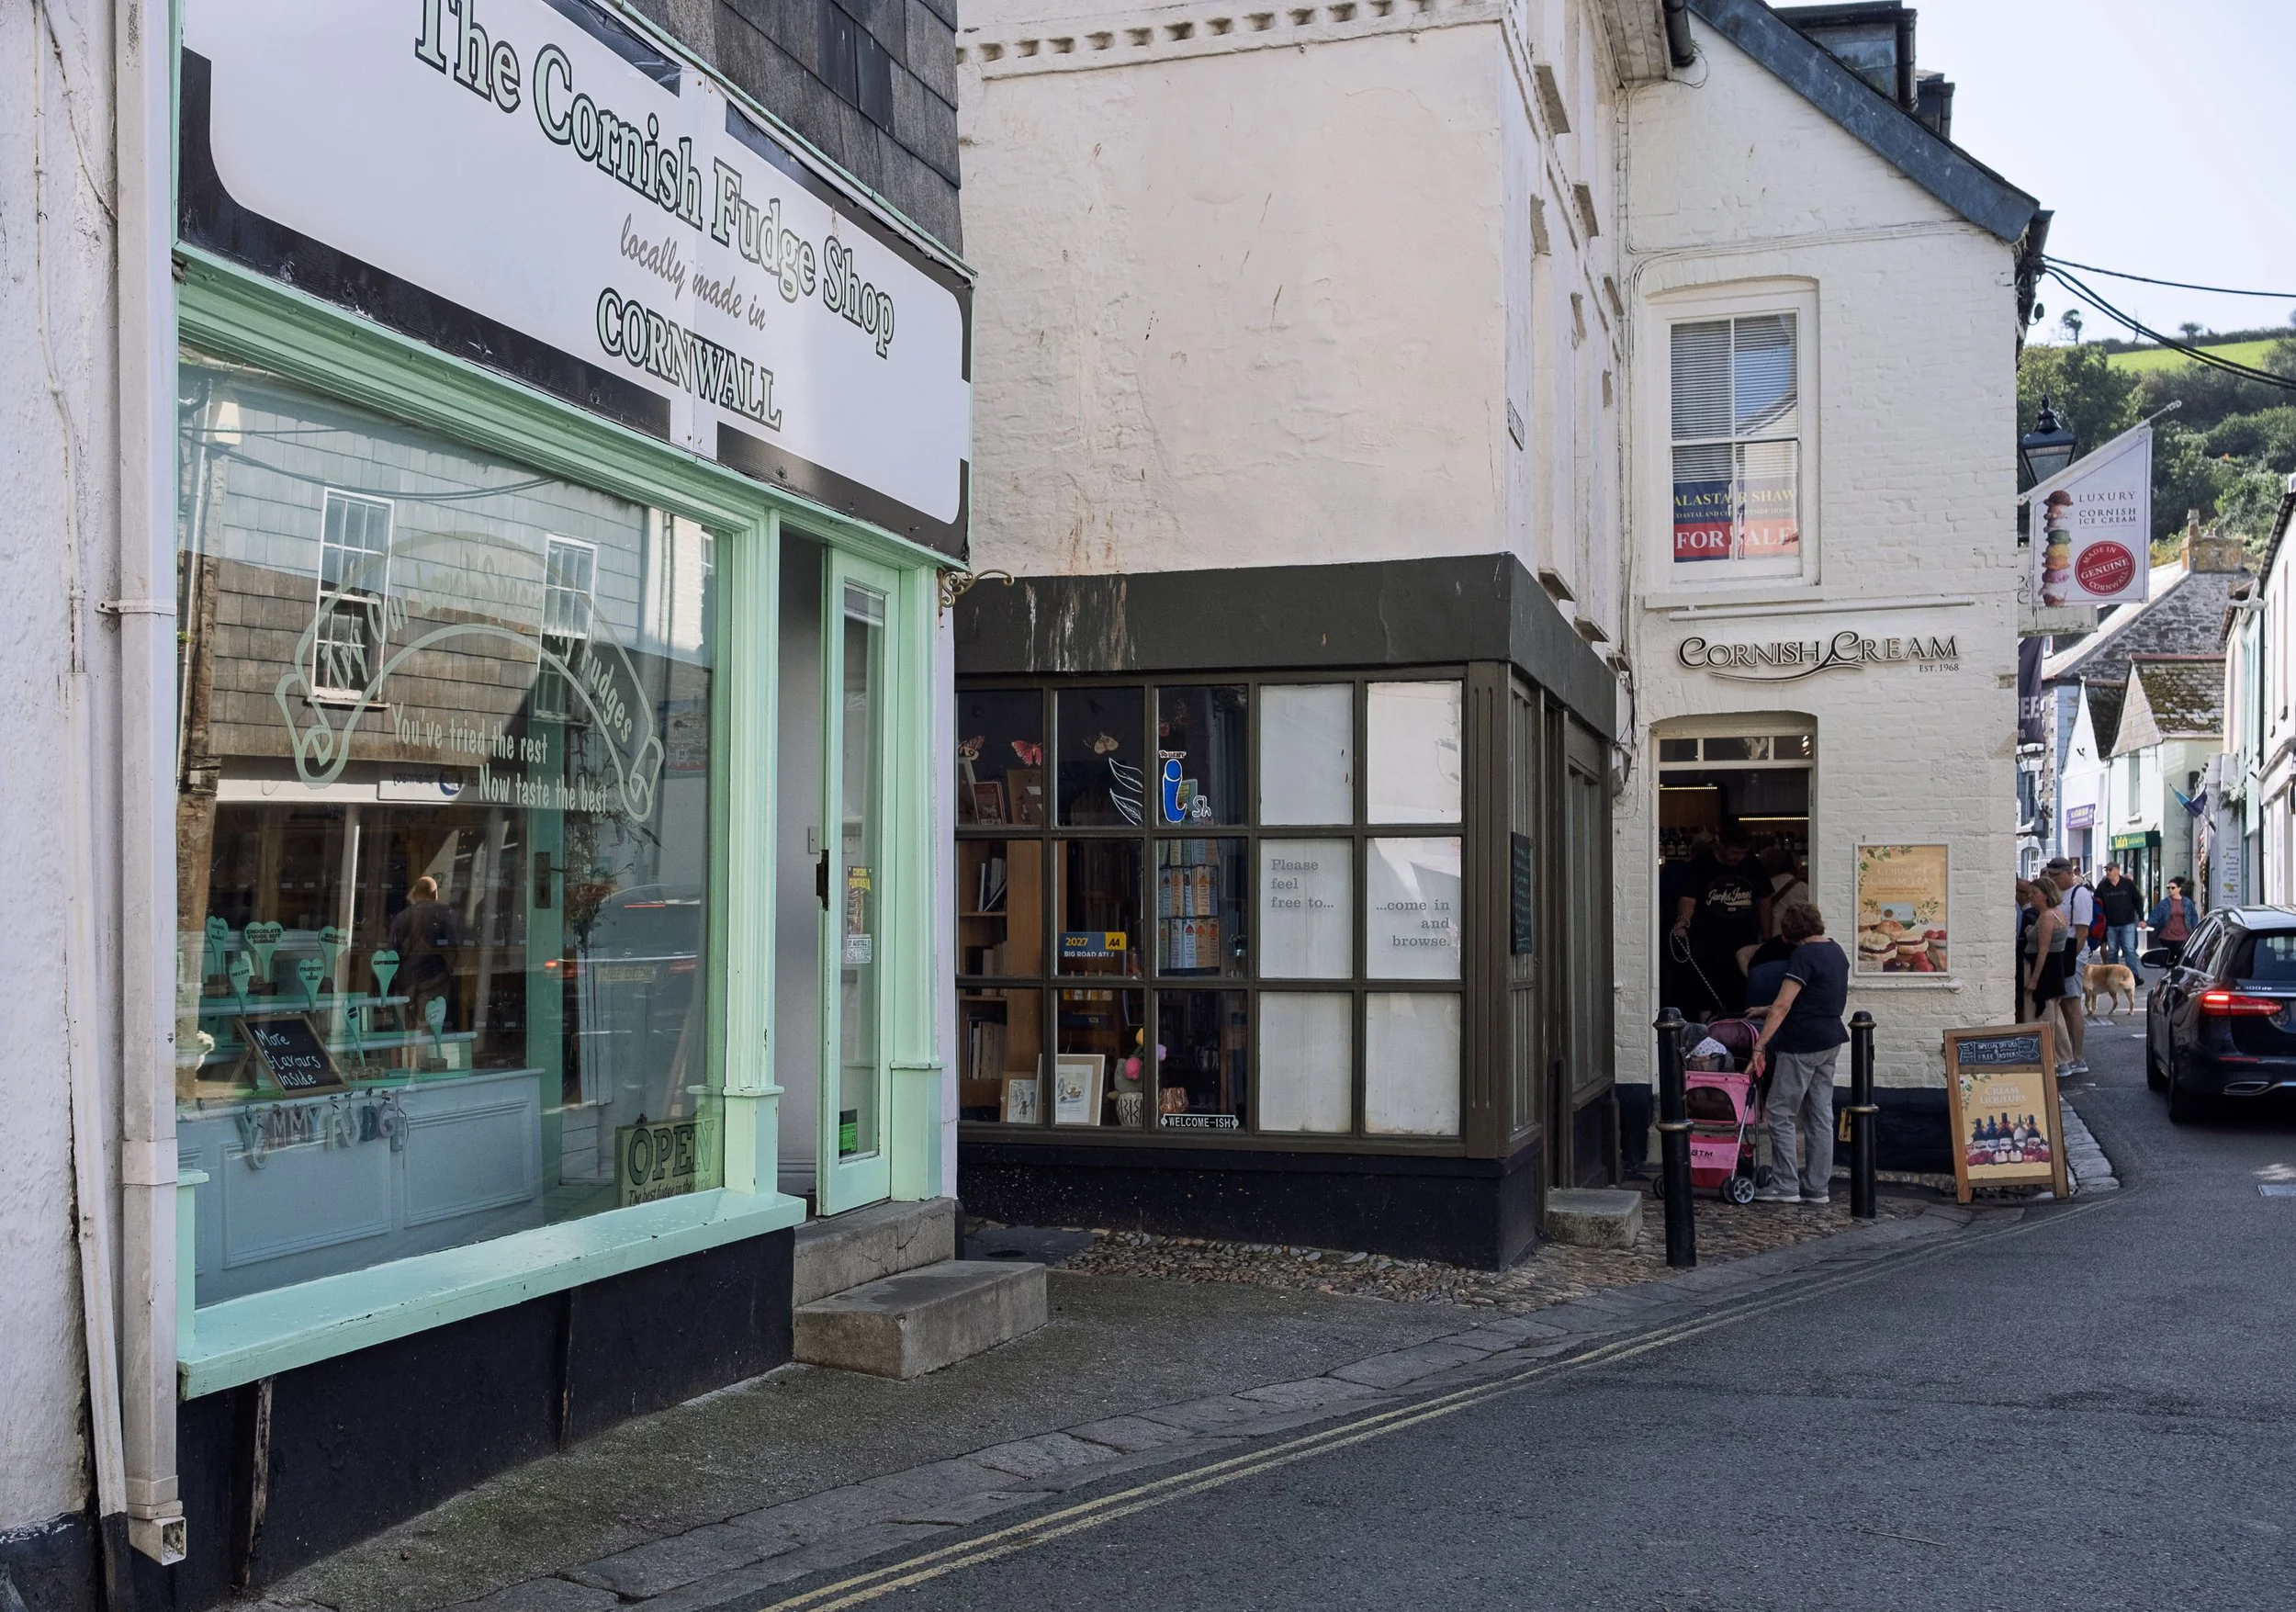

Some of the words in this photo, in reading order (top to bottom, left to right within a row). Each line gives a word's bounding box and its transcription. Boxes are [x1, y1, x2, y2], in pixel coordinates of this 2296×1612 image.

[415, 0, 521, 114] The
[533, 43, 703, 232] Cornish
[711, 156, 816, 303] Fudge
[823, 235, 895, 360] Shop
[620, 212, 687, 300] locally
[692, 272, 744, 323] made
[749, 295, 766, 331] in
[596, 287, 782, 432] CORNWALL
[1673, 491, 1747, 506] ALASTAR
[1751, 489, 1795, 502] SHAW
[2078, 490, 2136, 503] LUXURY
[2078, 507, 2136, 518] CORNISH
[1675, 530, 1726, 549] FOR
[2084, 547, 2106, 564] MADE
[2107, 546, 2117, 554] IN
[2080, 558, 2130, 580] GENUINE
[2088, 569, 2130, 592] CORNWALL
[1678, 636, 1820, 669] CORNISH
[1828, 630, 1960, 664] CREAM
[1939, 663, 1960, 672] 1968
[390, 701, 443, 750] You've
[450, 717, 485, 757] tried
[491, 720, 515, 761] the
[520, 732, 548, 765] rest
[478, 762, 511, 804] Now
[515, 772, 549, 808] taste
[555, 773, 576, 811] the
[581, 776, 608, 815] best
[1271, 859, 1319, 871] Please
[1271, 877, 1299, 890] feel
[1271, 896, 1301, 908] free
[1308, 896, 1334, 908] to...
[1376, 900, 1427, 911] ...come
[1434, 898, 1450, 910] in
[1421, 918, 1450, 929] and
[1065, 937, 1088, 947] 2027
[1108, 938, 1120, 947] AA
[1392, 934, 1451, 947] browse.
[254, 1028, 290, 1047] More
[1168, 1116, 1231, 1128] WELCOME-ISH
[627, 1120, 715, 1187] OPEN
